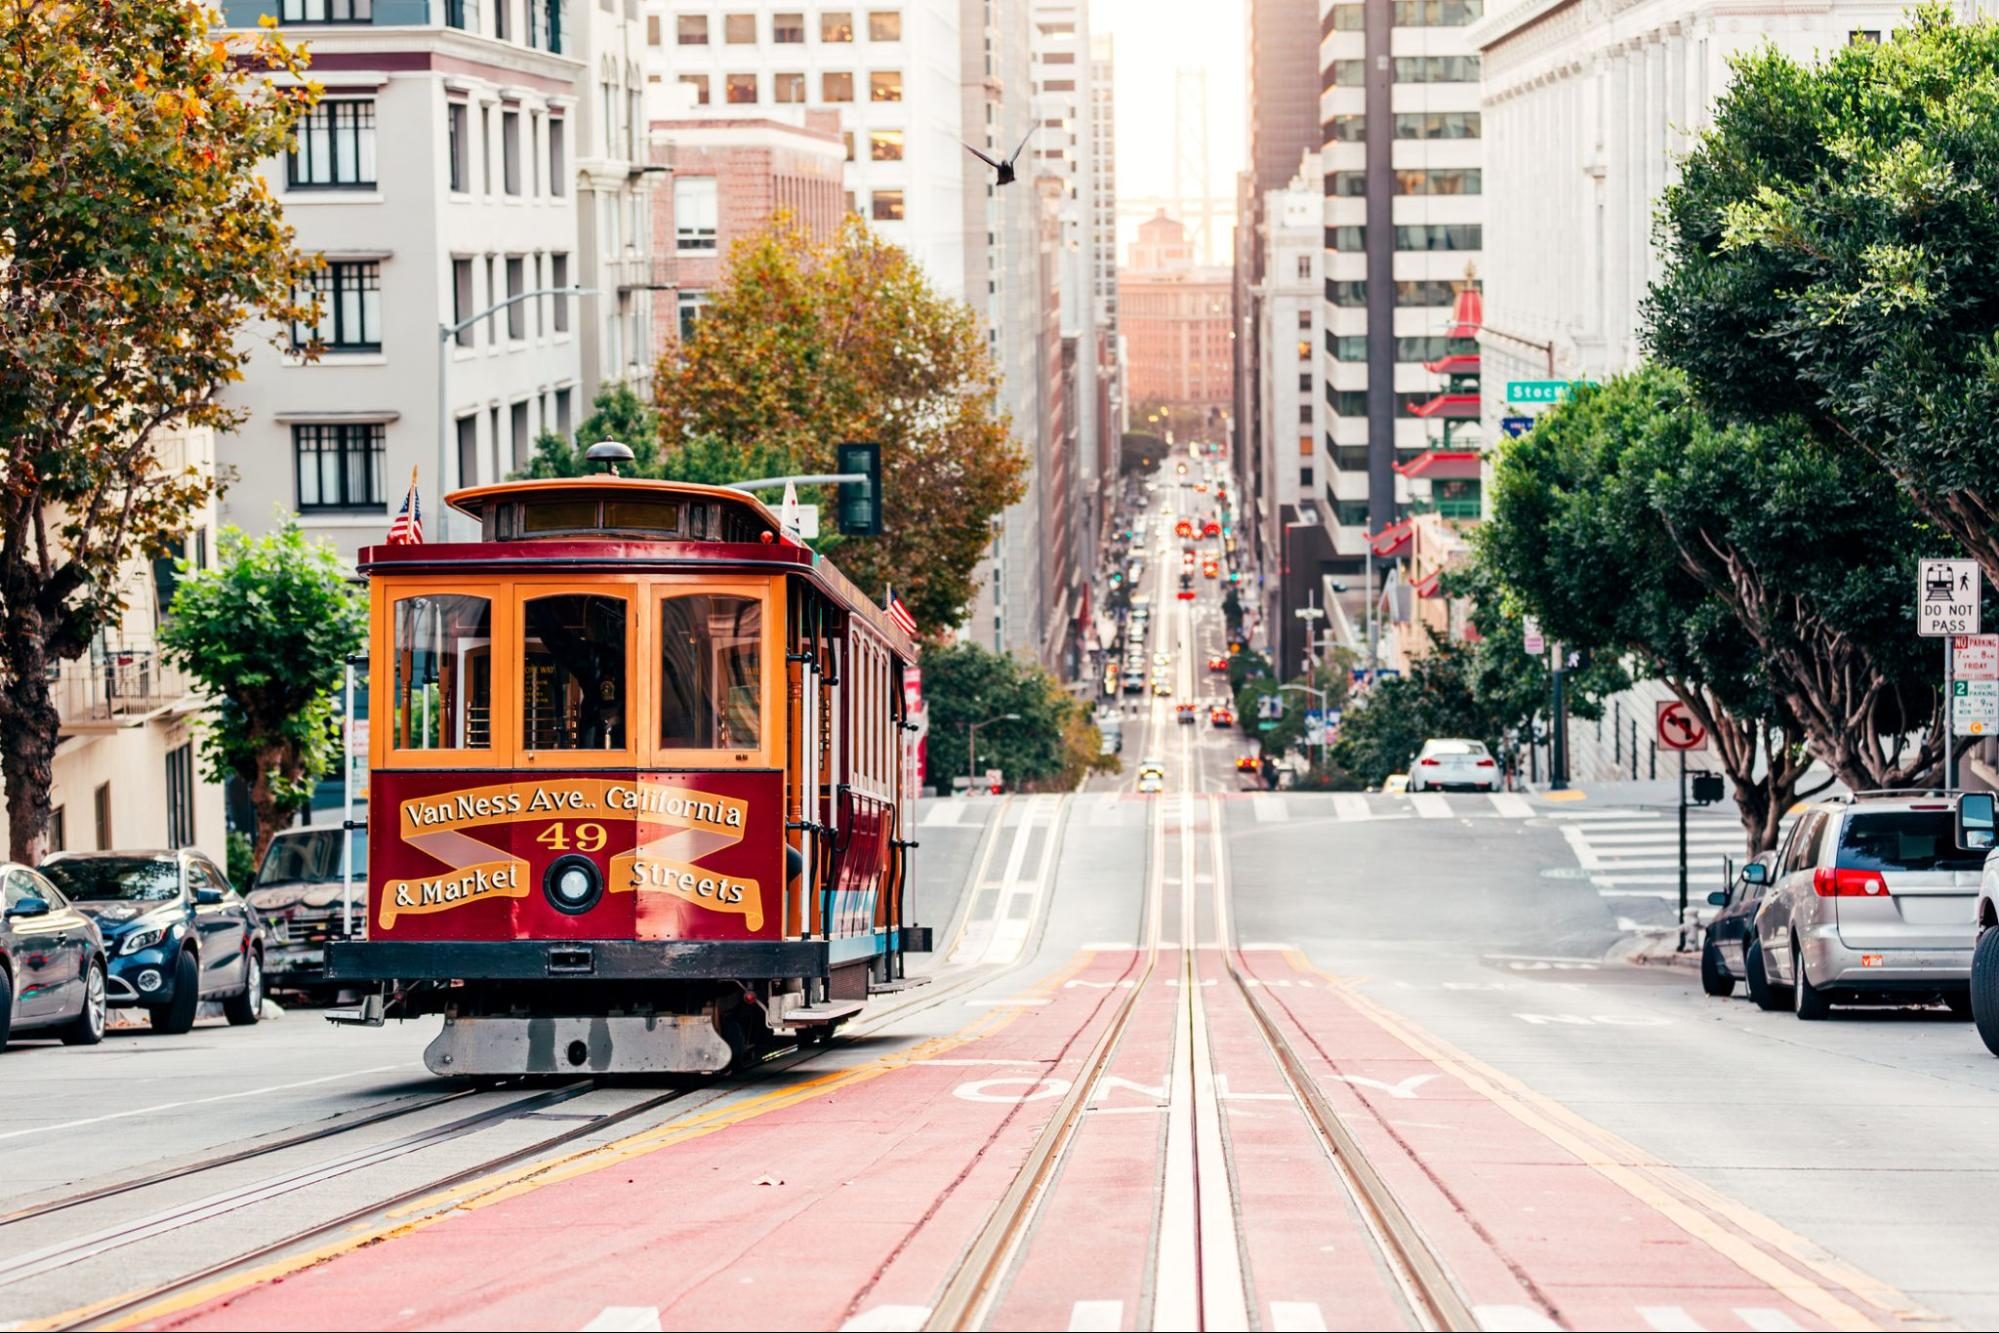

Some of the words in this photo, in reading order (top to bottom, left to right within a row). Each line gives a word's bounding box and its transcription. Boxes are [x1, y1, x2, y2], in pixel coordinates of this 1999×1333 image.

[1925, 605, 1941, 616] DO
[1949, 605, 1973, 616] NOT
[1932, 620, 1966, 631] PASS
[1955, 637, 1967, 648] NO
[1970, 639, 1996, 647] PARKING
[1956, 682, 1965, 695] 2
[605, 786, 741, 827] California
[536, 822, 607, 852] 49
[396, 883, 415, 906] &
[419, 866, 517, 907] Market
[630, 862, 746, 904] Streets
[952, 1073, 1441, 1103] ONLY
